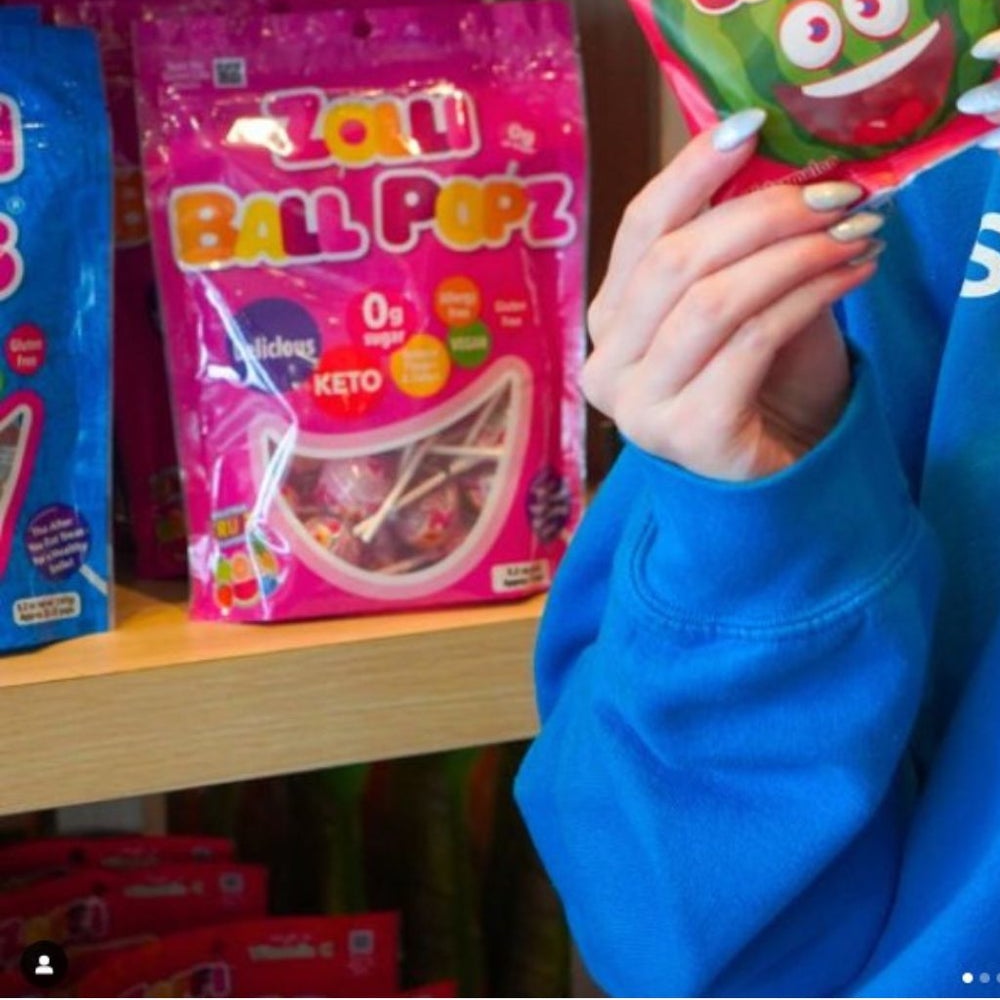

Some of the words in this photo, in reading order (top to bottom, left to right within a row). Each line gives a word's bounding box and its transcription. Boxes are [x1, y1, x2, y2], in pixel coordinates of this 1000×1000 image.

[169, 183, 370, 272] BALL
[373, 167, 577, 252] POPZ
[362, 292, 404, 328] 0g
[314, 369, 383, 396] KETO
